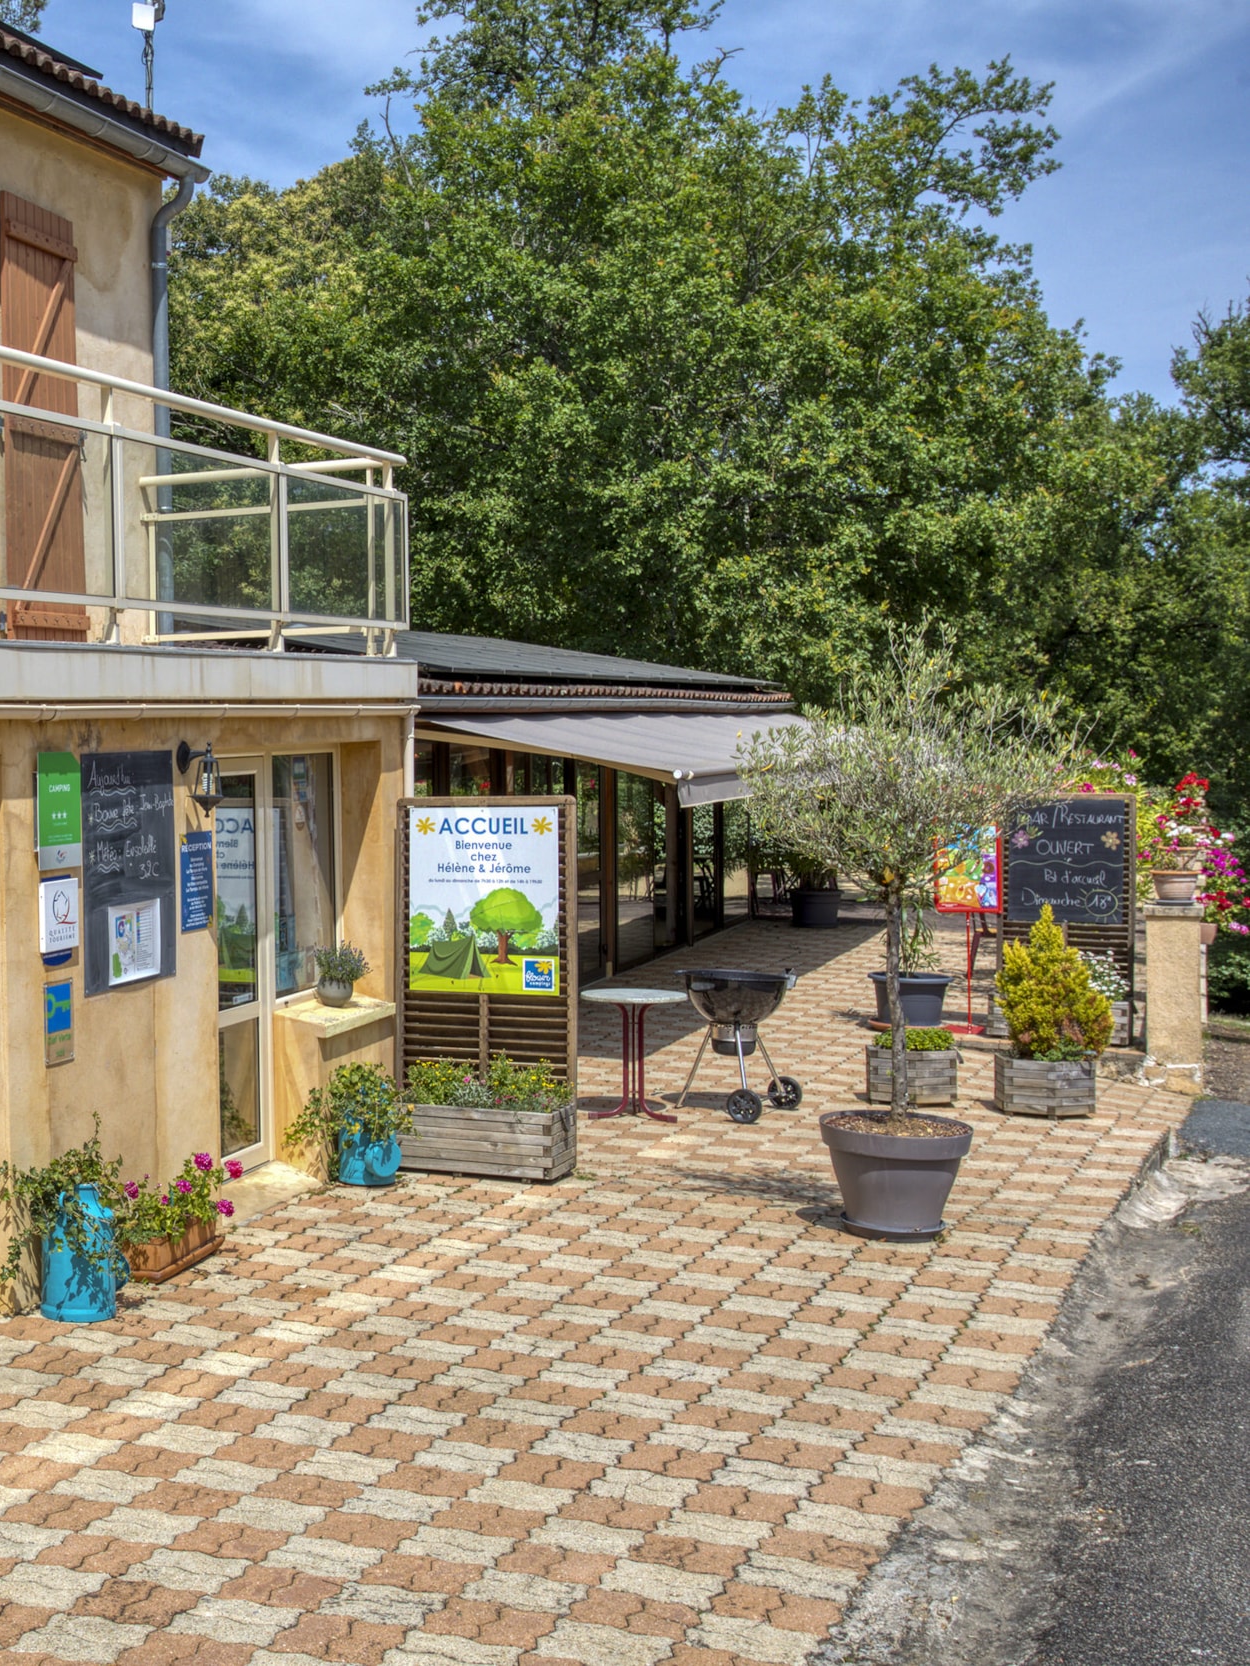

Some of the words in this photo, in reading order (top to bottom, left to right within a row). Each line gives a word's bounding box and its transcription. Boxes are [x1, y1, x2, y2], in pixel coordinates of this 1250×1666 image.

[49, 783, 71, 793] CAMPING
[439, 817, 528, 835] ACCUEIL
[455, 840, 512, 850] Bienvenue
[1036, 839, 1094, 855] OUVERT
[470, 852, 497, 861] chez
[437, 862, 475, 873] Hélène
[478, 864, 486, 873] &
[489, 863, 531, 873] Jérôme
[1022, 887, 1081, 907] Dimanche
[49, 933, 75, 943] TOURISME
